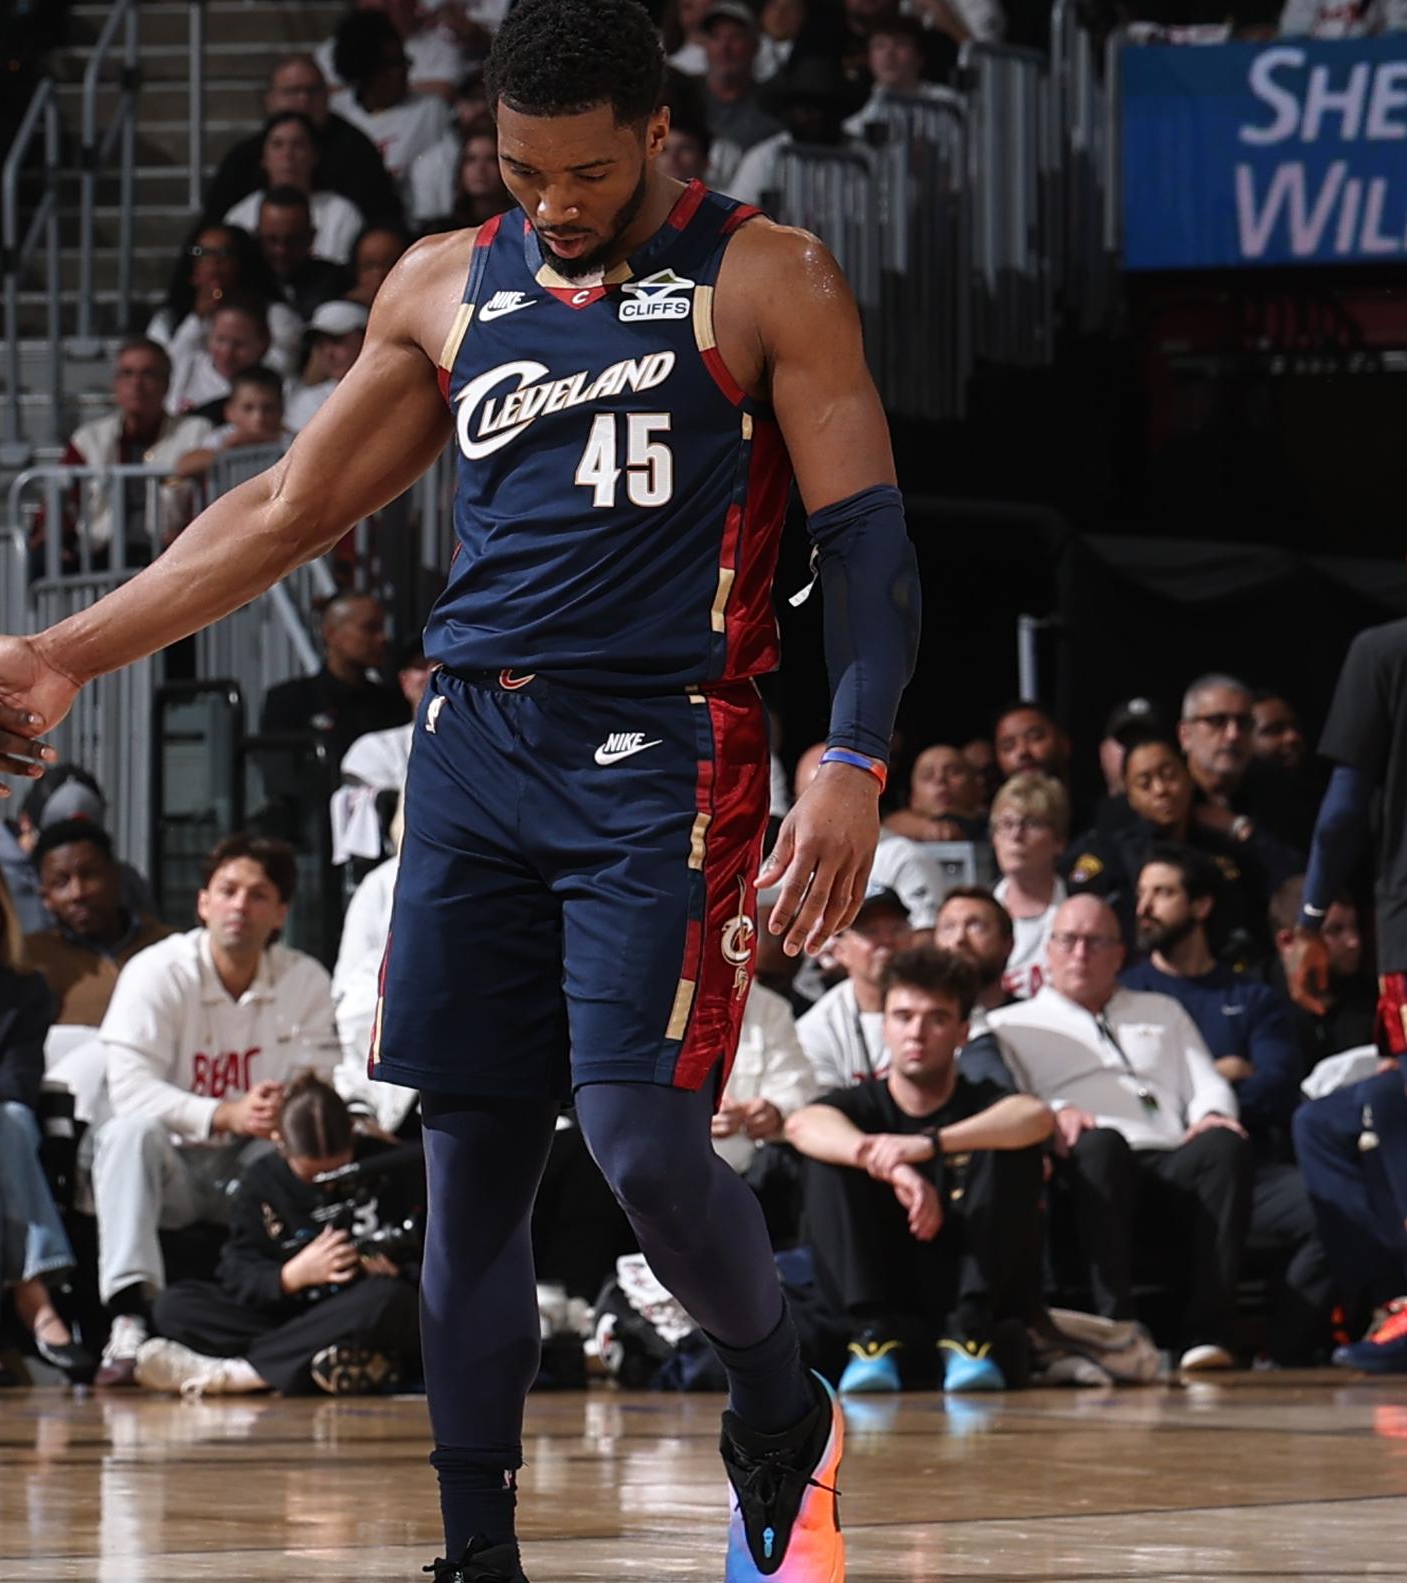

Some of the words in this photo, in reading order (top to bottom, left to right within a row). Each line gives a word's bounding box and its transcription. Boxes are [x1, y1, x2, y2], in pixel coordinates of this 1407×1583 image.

[1235, 159, 1407, 257] WIL
[487, 291, 525, 311] NIKE
[622, 302, 687, 317] CLIFFS
[454, 350, 676, 460] CLEVELAND
[574, 412, 673, 507] 45
[603, 732, 646, 753] NIKE
